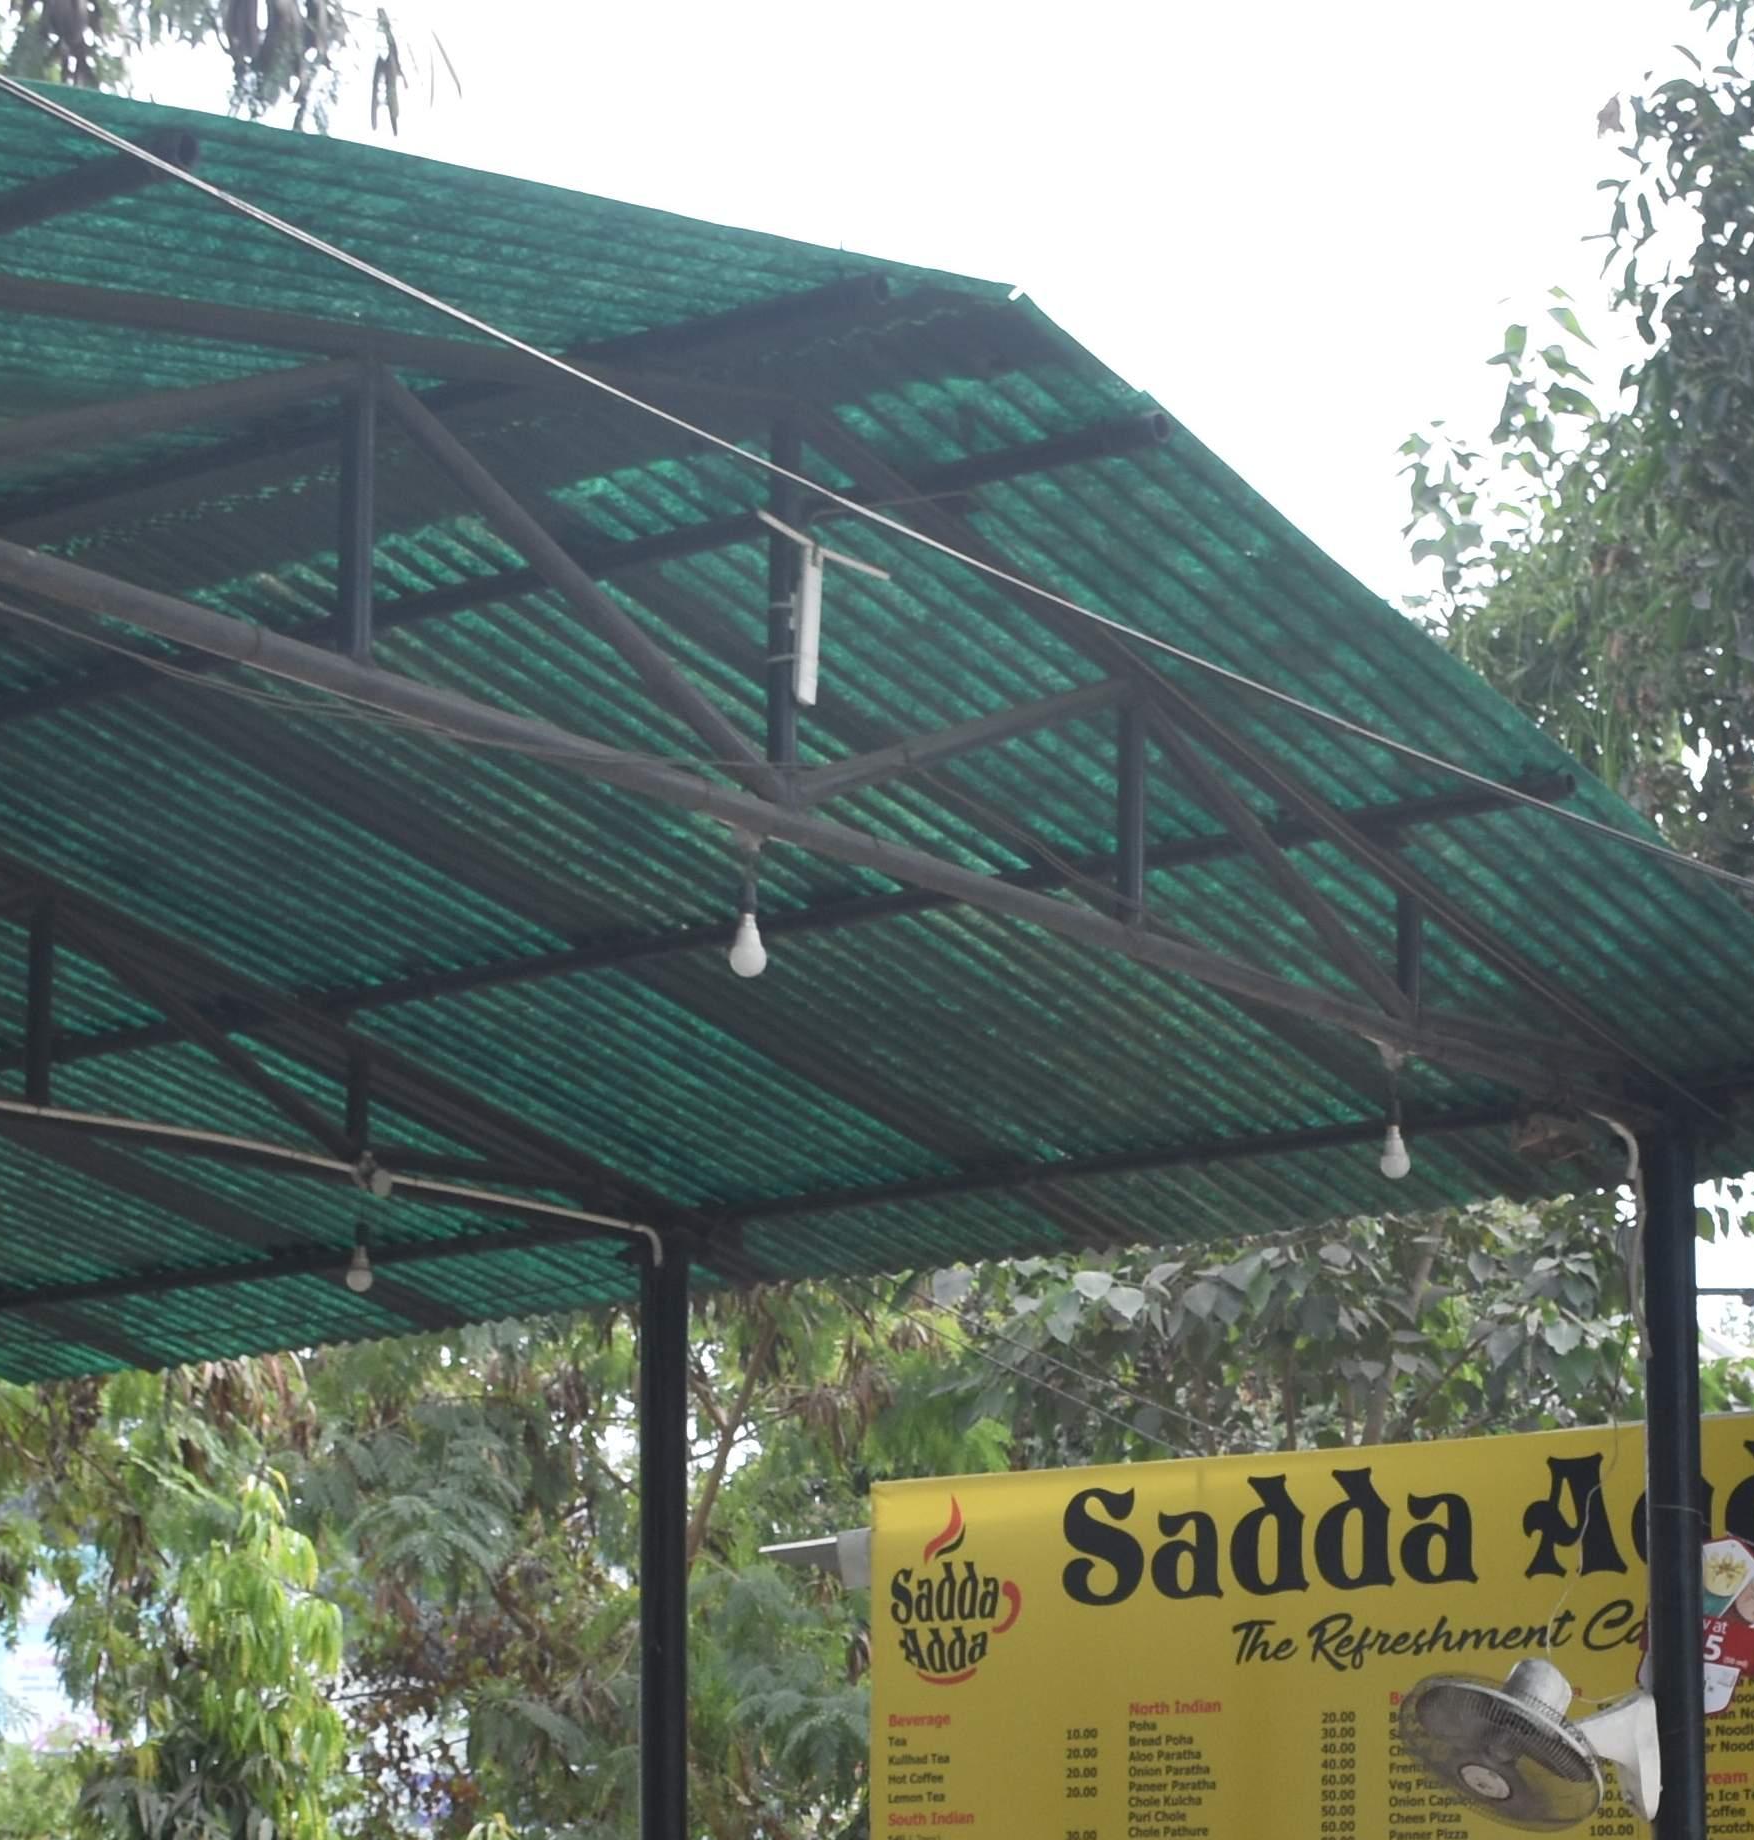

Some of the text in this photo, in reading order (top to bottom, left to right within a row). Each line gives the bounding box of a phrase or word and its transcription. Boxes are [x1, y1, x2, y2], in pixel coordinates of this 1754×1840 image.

[1062, 1466, 1479, 1606] Sadda
[891, 1561, 999, 1624] Sadda
[1713, 1622, 1728, 1634] at
[1233, 1599, 1647, 1672] The Refreshment Ca
[899, 1627, 988, 1674] Adda
[1130, 1701, 1221, 1715] North Indian
[889, 1714, 951, 1728] Beverage
[1322, 1712, 1356, 1723] 20.00
[1130, 1721, 1157, 1731] Poha
[1067, 1728, 1097, 1740] 10.00
[1322, 1727, 1355, 1739] 30.00
[888, 1737, 907, 1747] Tea
[1130, 1735, 1193, 1747] Bread Poha
[1067, 1748, 1097, 1759] 20.00
[1321, 1743, 1355, 1754] 40.00
[889, 1753, 950, 1766] Kullhad Tea
[1130, 1750, 1201, 1762] Aloo Paratha
[1321, 1759, 1355, 1770] 40.00
[1067, 1768, 1097, 1778] 20.00
[1129, 1765, 1210, 1777] Onion Paratha
[888, 1773, 943, 1784] Hot Coffee
[1321, 1774, 1355, 1785] 60.00
[1705, 1771, 1748, 1785] ream
[1129, 1780, 1216, 1792] Paneer Paratha
[1389, 1779, 1412, 1792] Veg
[888, 1792, 945, 1803] Lemon Tea
[1067, 1787, 1097, 1798] 20.00
[1321, 1789, 1355, 1801] 50.00
[1719, 1790, 1740, 1801] Ice
[1129, 1796, 1202, 1807] Chole Kulcha
[1389, 1796, 1424, 1807] Onion
[1129, 1811, 1186, 1822] Puri Chole
[1321, 1805, 1355, 1817] 50.00
[889, 1812, 975, 1825] South Indian
[1389, 1812, 1461, 1824] Chees Pizza
[1128, 1826, 1209, 1838] Chole Pathure
[1321, 1821, 1355, 1832] 60.00
[1591, 1825, 1633, 1836] 100.00
[1066, 1830, 1096, 1840] 30.00
[1389, 1829, 1468, 1840] Panner Pizza
